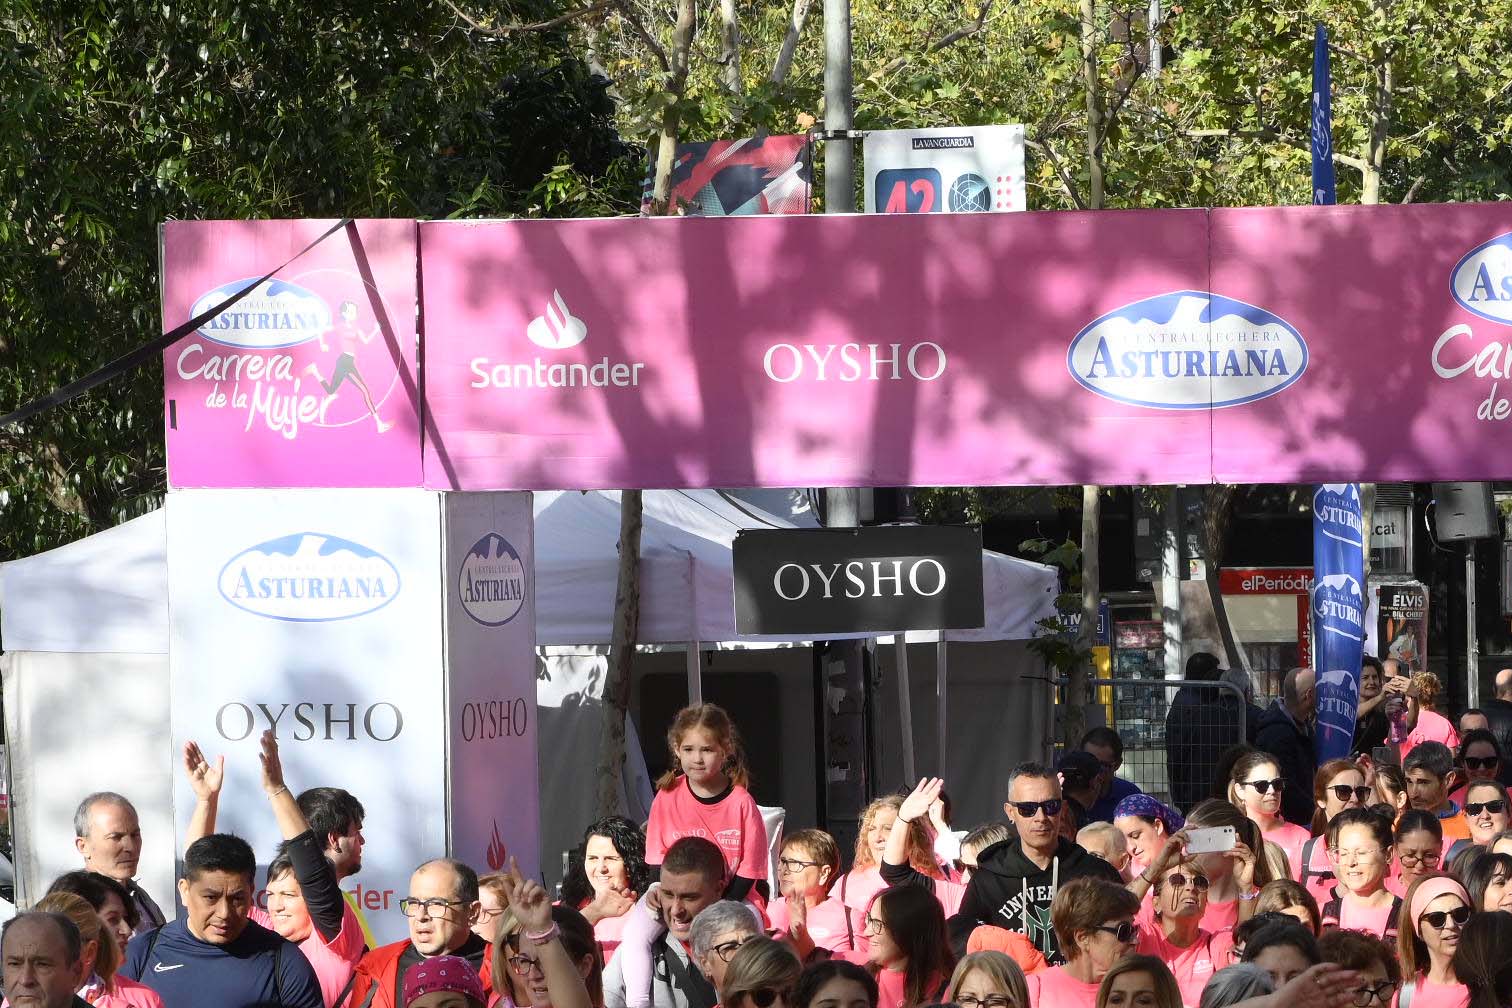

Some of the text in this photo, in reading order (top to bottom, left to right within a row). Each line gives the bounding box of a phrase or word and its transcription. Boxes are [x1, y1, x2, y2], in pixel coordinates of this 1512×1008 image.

[177, 344, 293, 381] Carrera
[470, 357, 645, 388] Santander
[763, 341, 947, 383] OYSHO
[1086, 335, 1290, 379] ASTURIANA
[206, 377, 339, 439] de la Mujer
[1477, 381, 1511, 420] de
[232, 566, 388, 600] ASTURIANA
[464, 567, 523, 603] ASTURIANA
[774, 558, 946, 600] OYSHO
[1393, 595, 1423, 607] ELVIS
[216, 702, 404, 742] OYSHO
[461, 697, 527, 742] OYSHO
